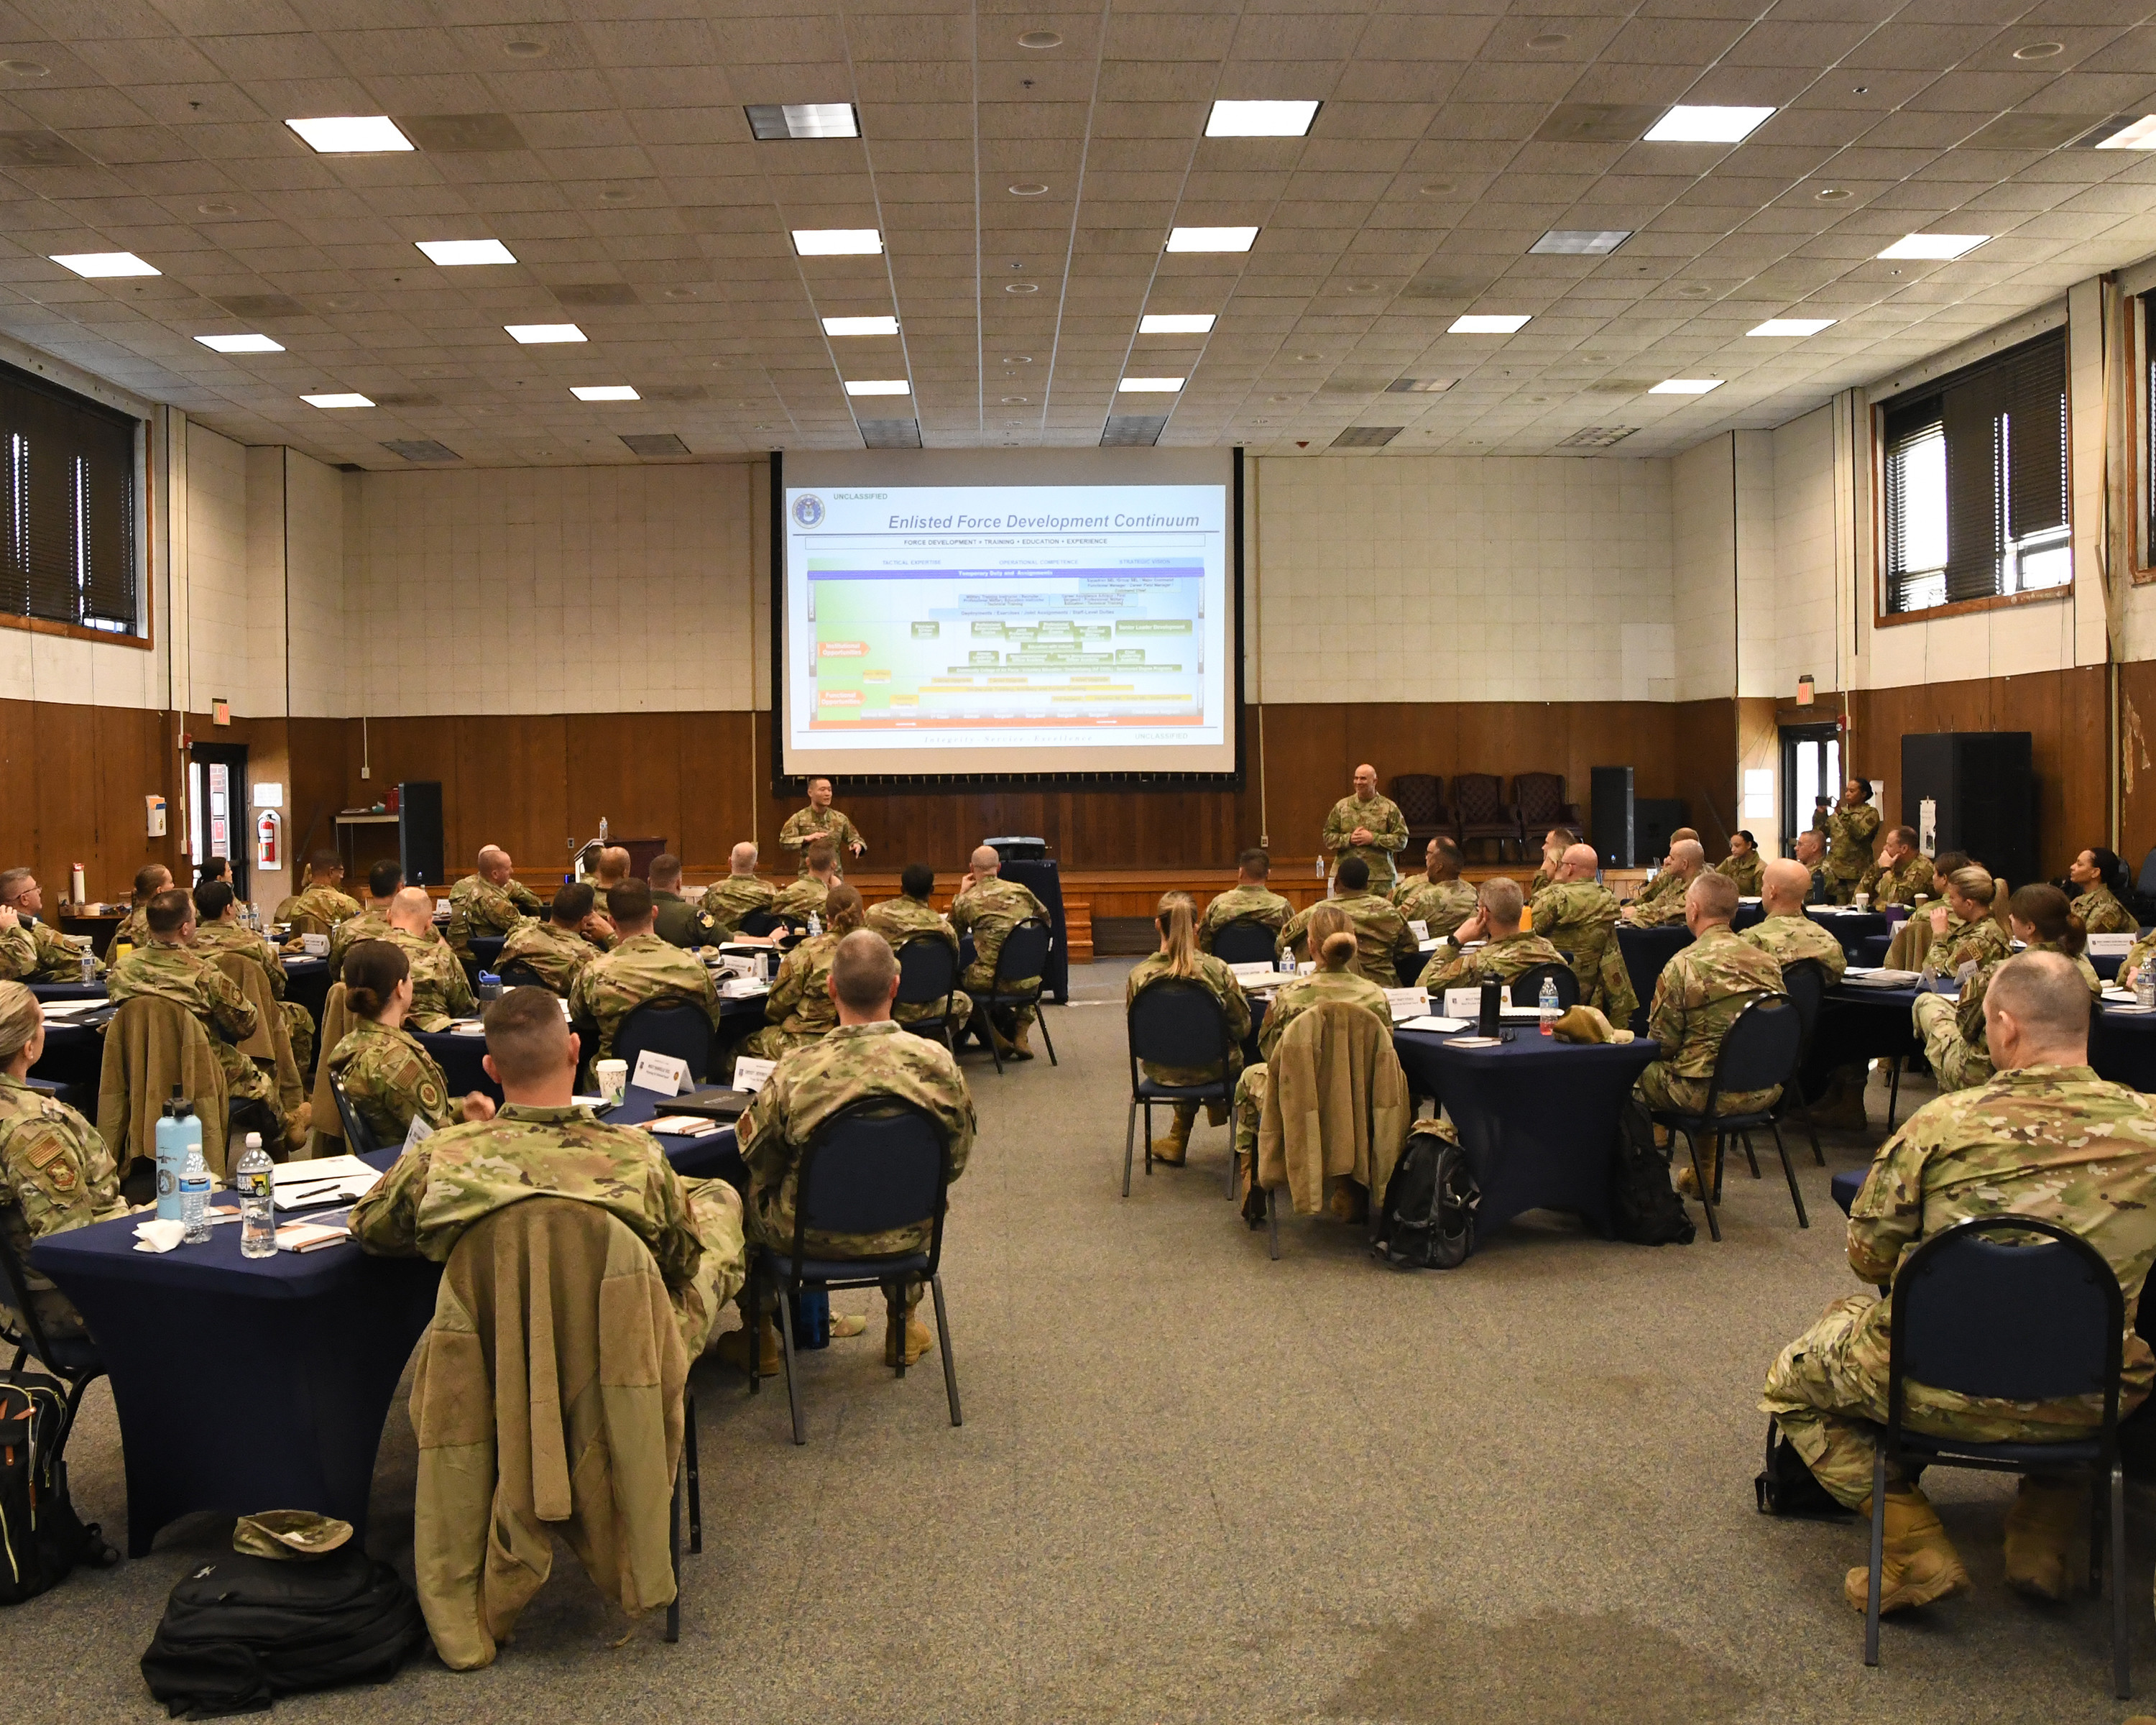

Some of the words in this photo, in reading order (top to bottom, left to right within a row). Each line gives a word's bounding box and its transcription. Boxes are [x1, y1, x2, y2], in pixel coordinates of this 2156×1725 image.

[888, 515, 952, 529] Enlisted
[957, 515, 1002, 528] Force
[1006, 514, 1110, 531] Development
[1114, 513, 1200, 528] Continuum
